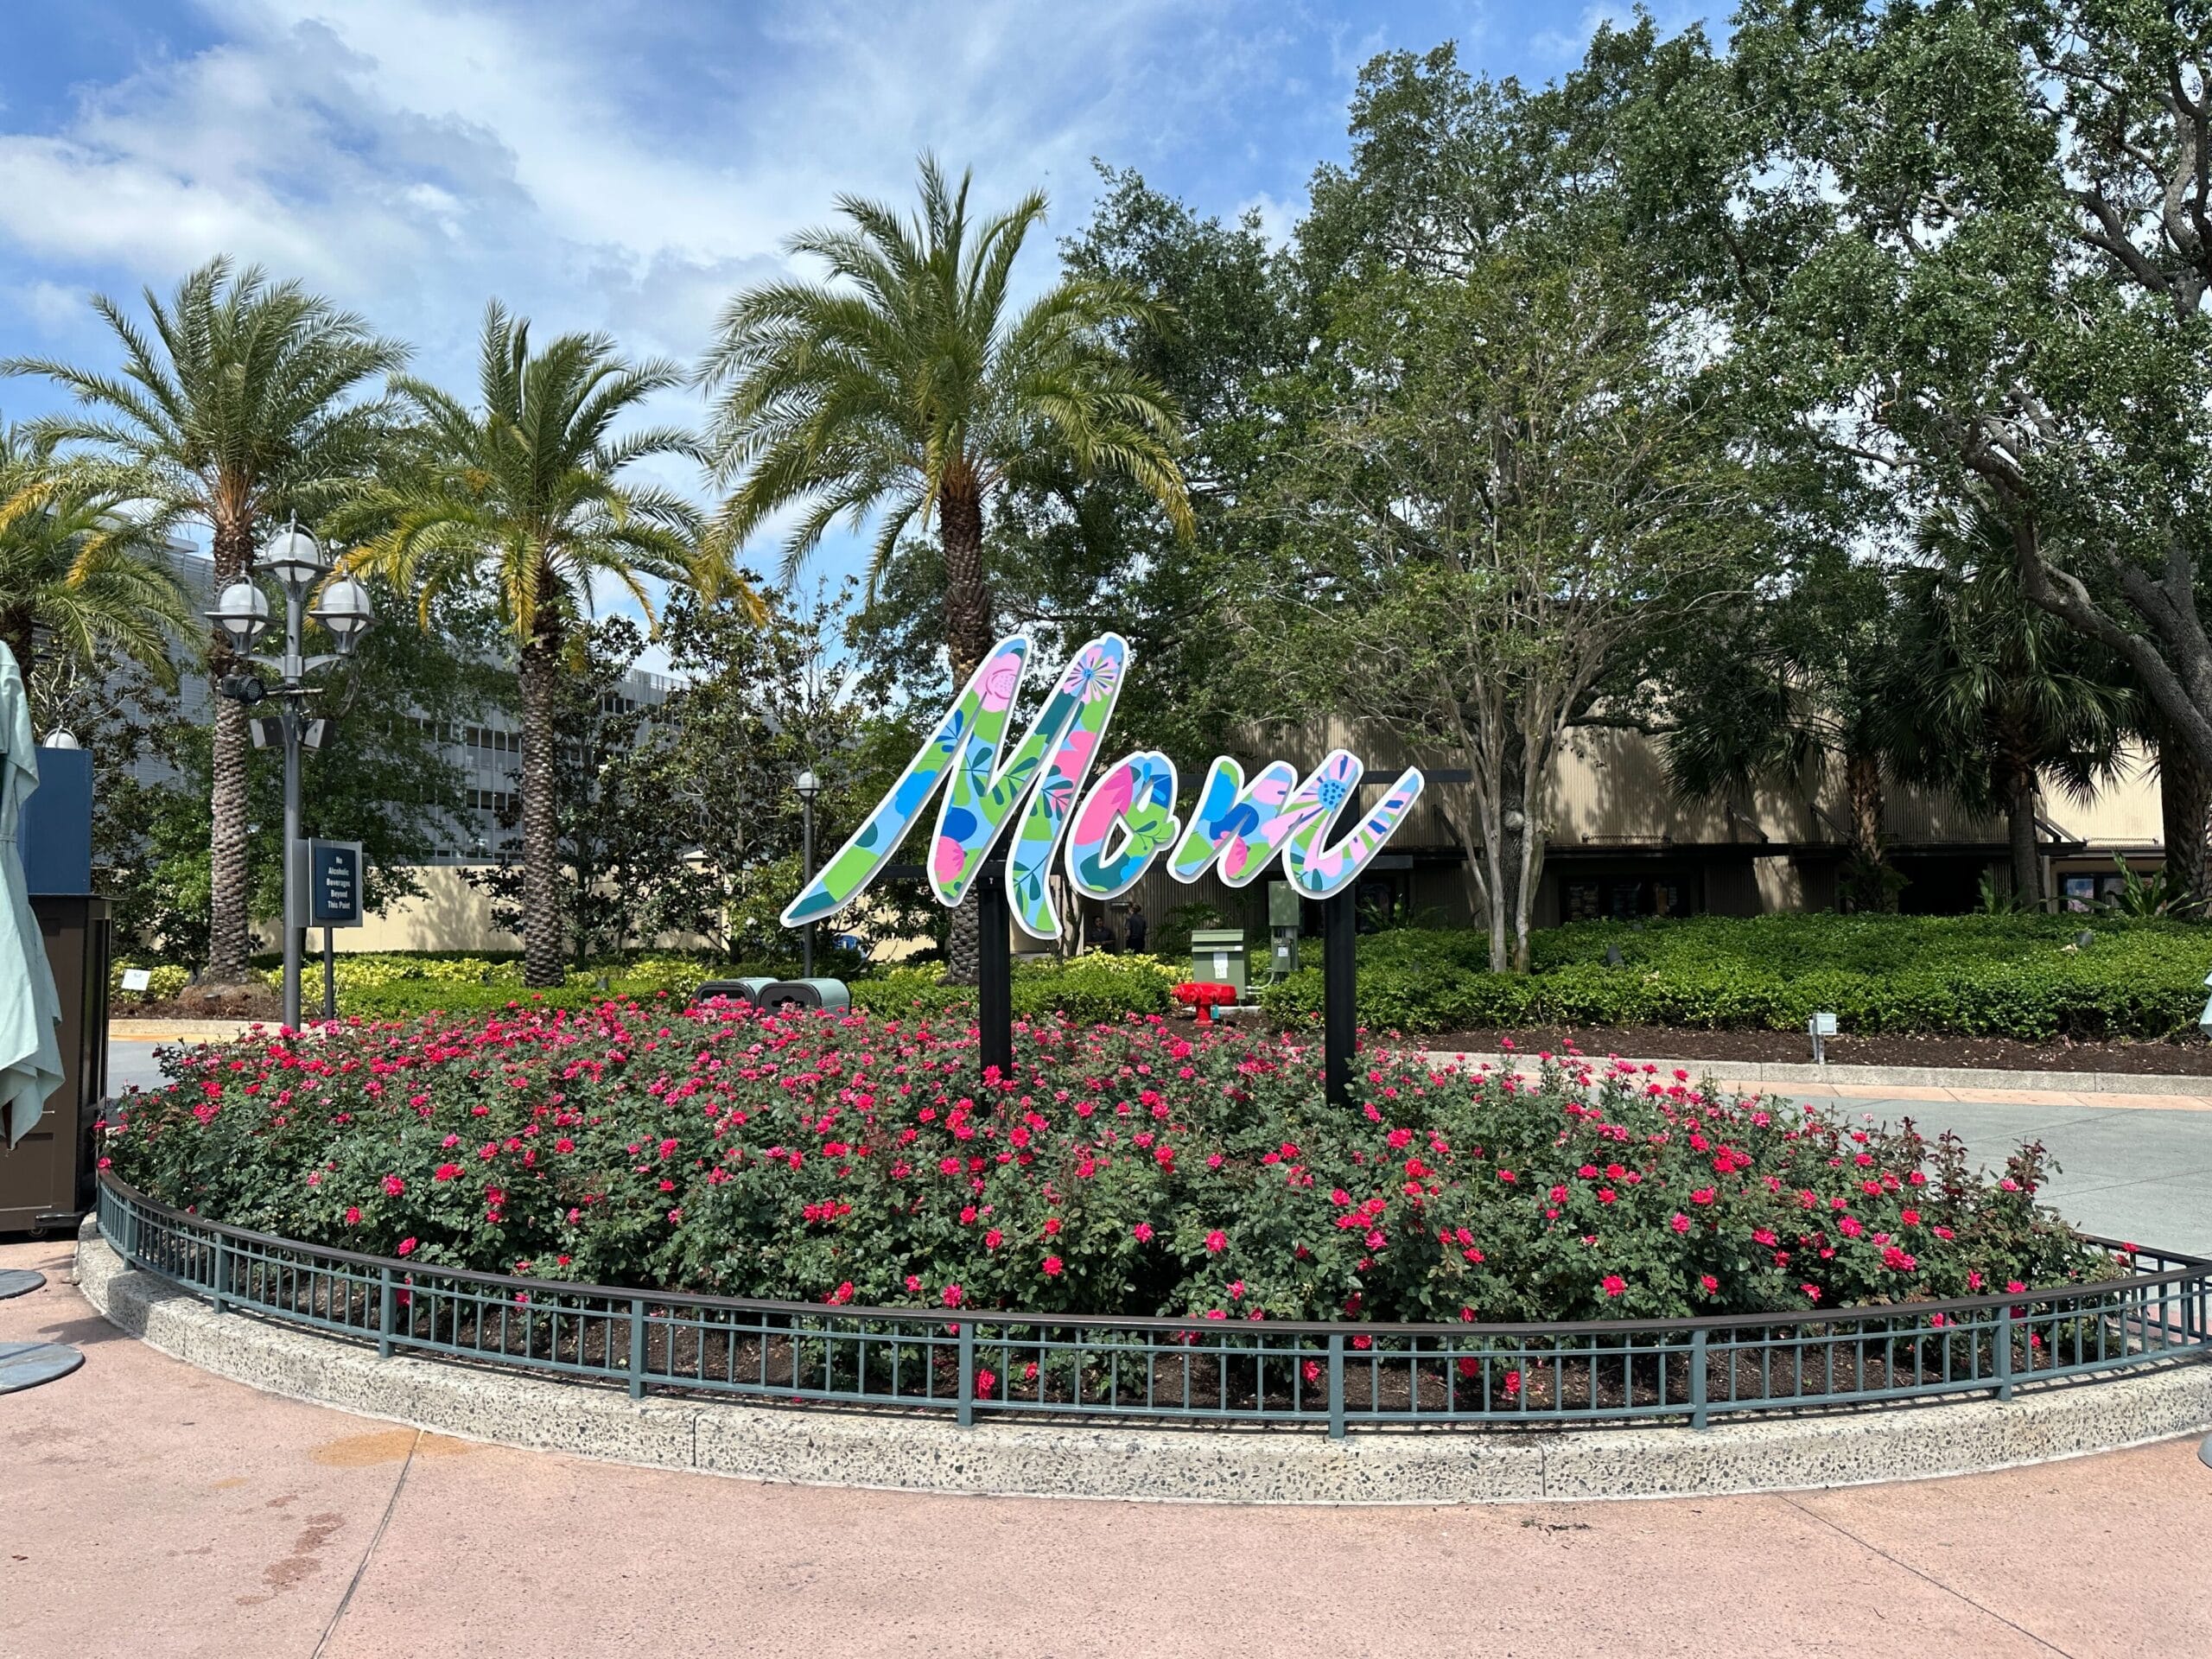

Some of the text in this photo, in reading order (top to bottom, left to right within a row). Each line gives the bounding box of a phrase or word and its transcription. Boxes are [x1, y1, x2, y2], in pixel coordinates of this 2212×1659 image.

[780, 632, 1424, 939] Mom
[327, 867, 349, 876] Alcoholic
[326, 878, 351, 887] Beverages
[330, 889, 348, 899] Beyond
[327, 900, 351, 910] This Point
